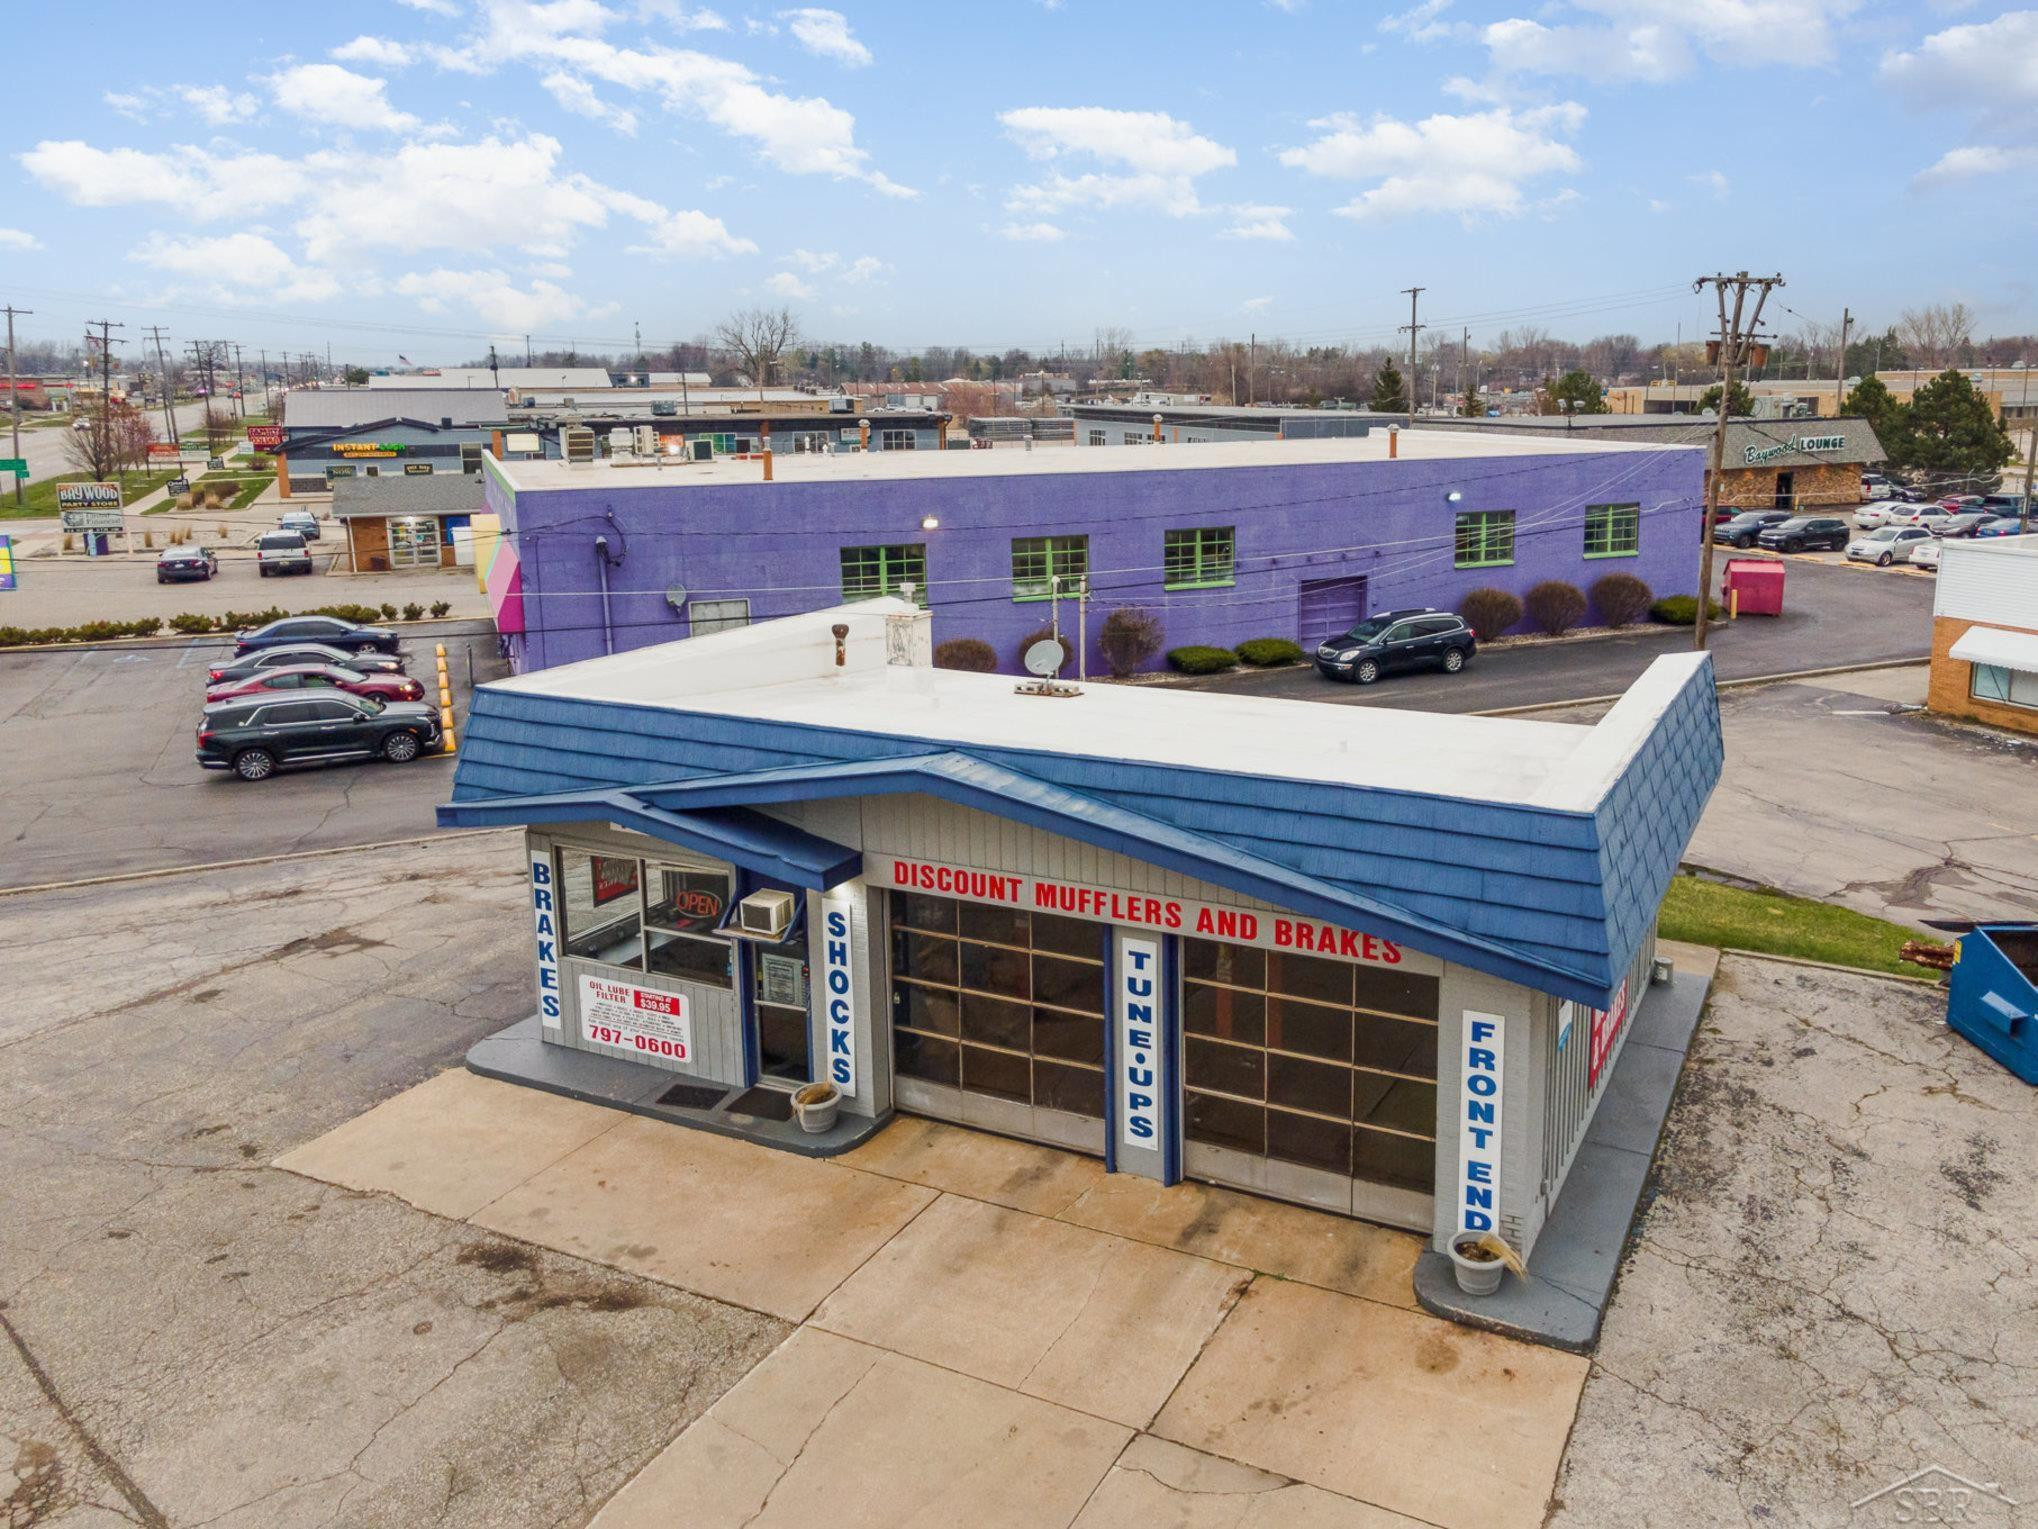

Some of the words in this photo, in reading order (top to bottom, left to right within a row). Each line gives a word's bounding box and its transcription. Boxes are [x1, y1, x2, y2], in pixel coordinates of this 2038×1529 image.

[332, 442, 378, 452] INSTANT
[1745, 434, 1796, 464] Baywood
[1800, 437, 1845, 450] LOUNGE
[60, 485, 118, 500] BAYWOOD
[676, 890, 719, 917] OPEN
[894, 861, 1022, 902] DISCOUNT
[1035, 882, 1182, 928] MUFFLERS
[1196, 908, 1257, 940] AND
[1275, 919, 1402, 964] BRAKES
[532, 861, 560, 1018] BRAKES
[589, 980, 604, 991] OIL
[607, 984, 630, 996] LUBE
[596, 991, 626, 1004] FILTER
[827, 910, 851, 1085] SHOCKS
[640, 999, 672, 1014] $39.95
[589, 1024, 686, 1058] 797-0600
[1466, 1021, 1497, 1150] FRONT
[1464, 1160, 1492, 1232] END
